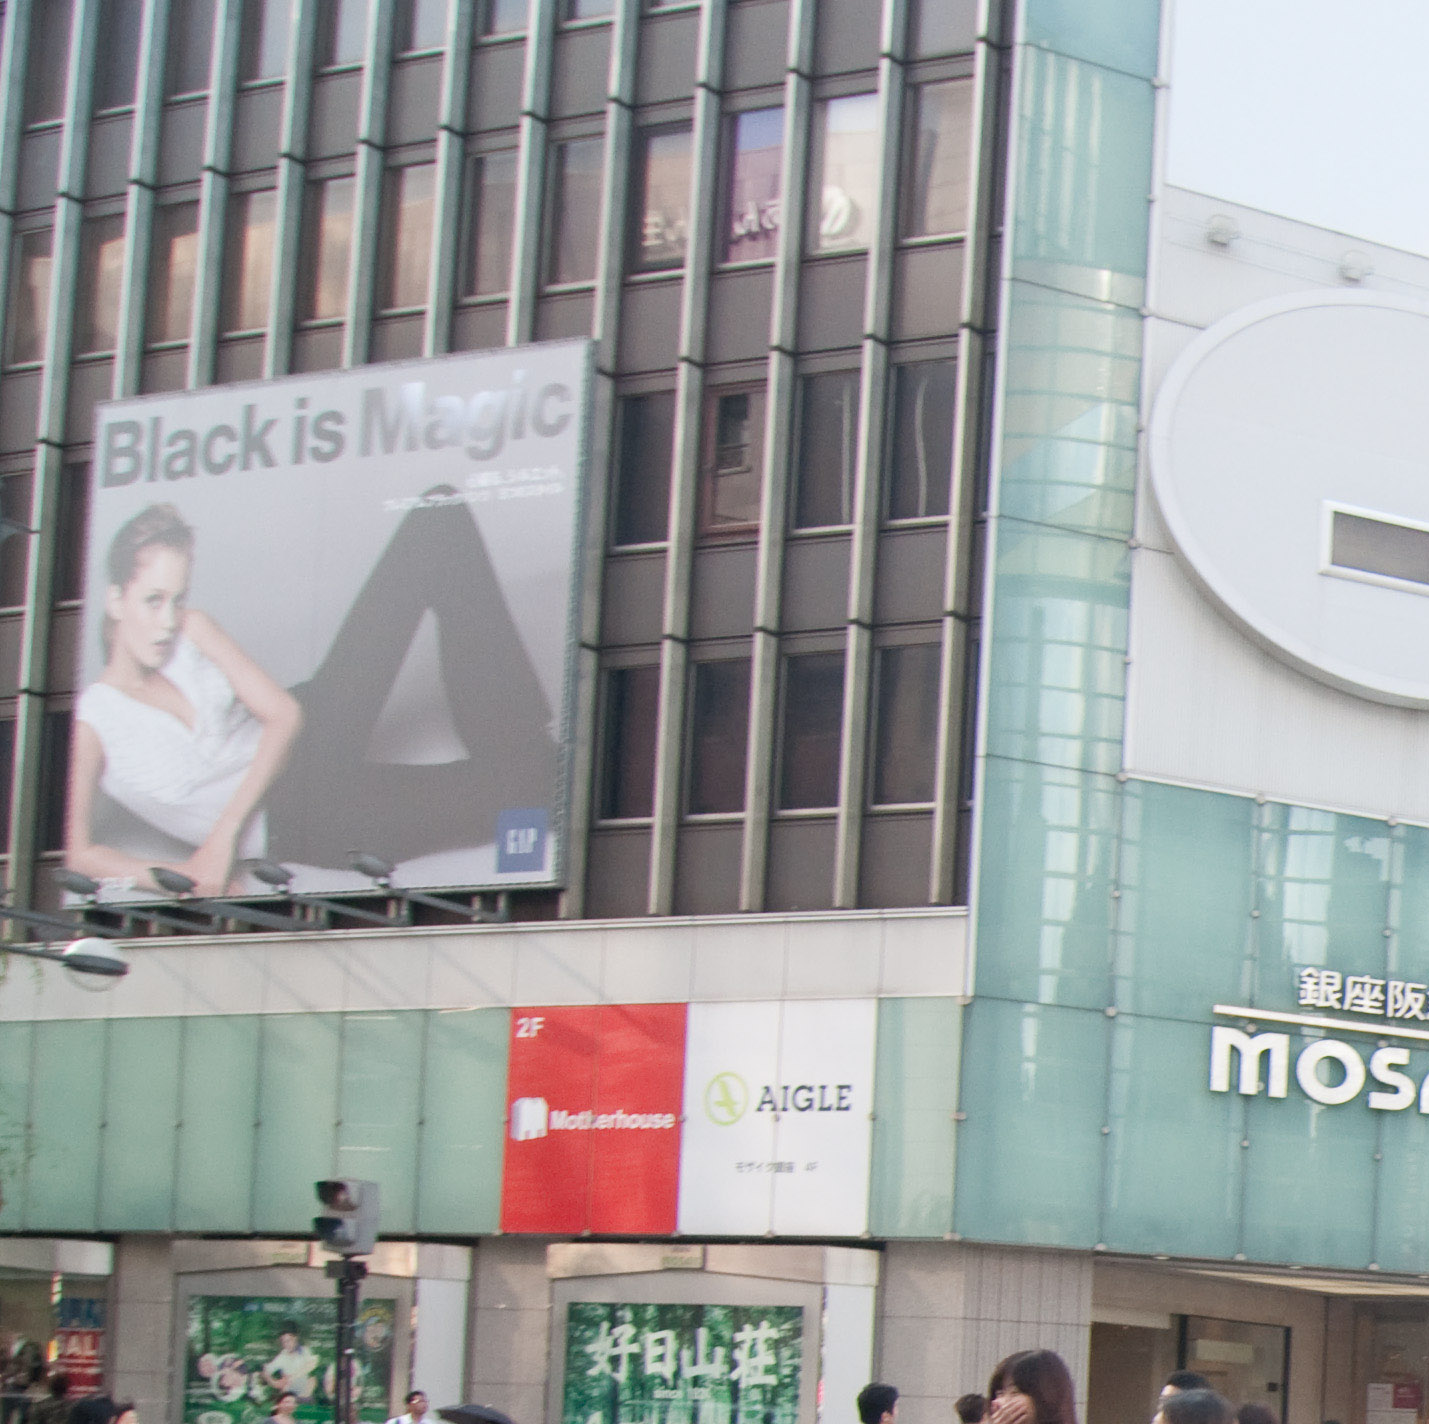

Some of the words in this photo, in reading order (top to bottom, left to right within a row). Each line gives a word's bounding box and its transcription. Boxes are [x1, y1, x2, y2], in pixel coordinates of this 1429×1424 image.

[101, 404, 278, 489] Black
[291, 397, 348, 466] is
[359, 369, 573, 463] Magic
[506, 828, 538, 854] GAP
[516, 1017, 545, 1038] 2F
[755, 1084, 854, 1113] AIGLE
[549, 1108, 676, 1131] Motherhouse
[584, 1320, 780, 1388] 好日山荘
